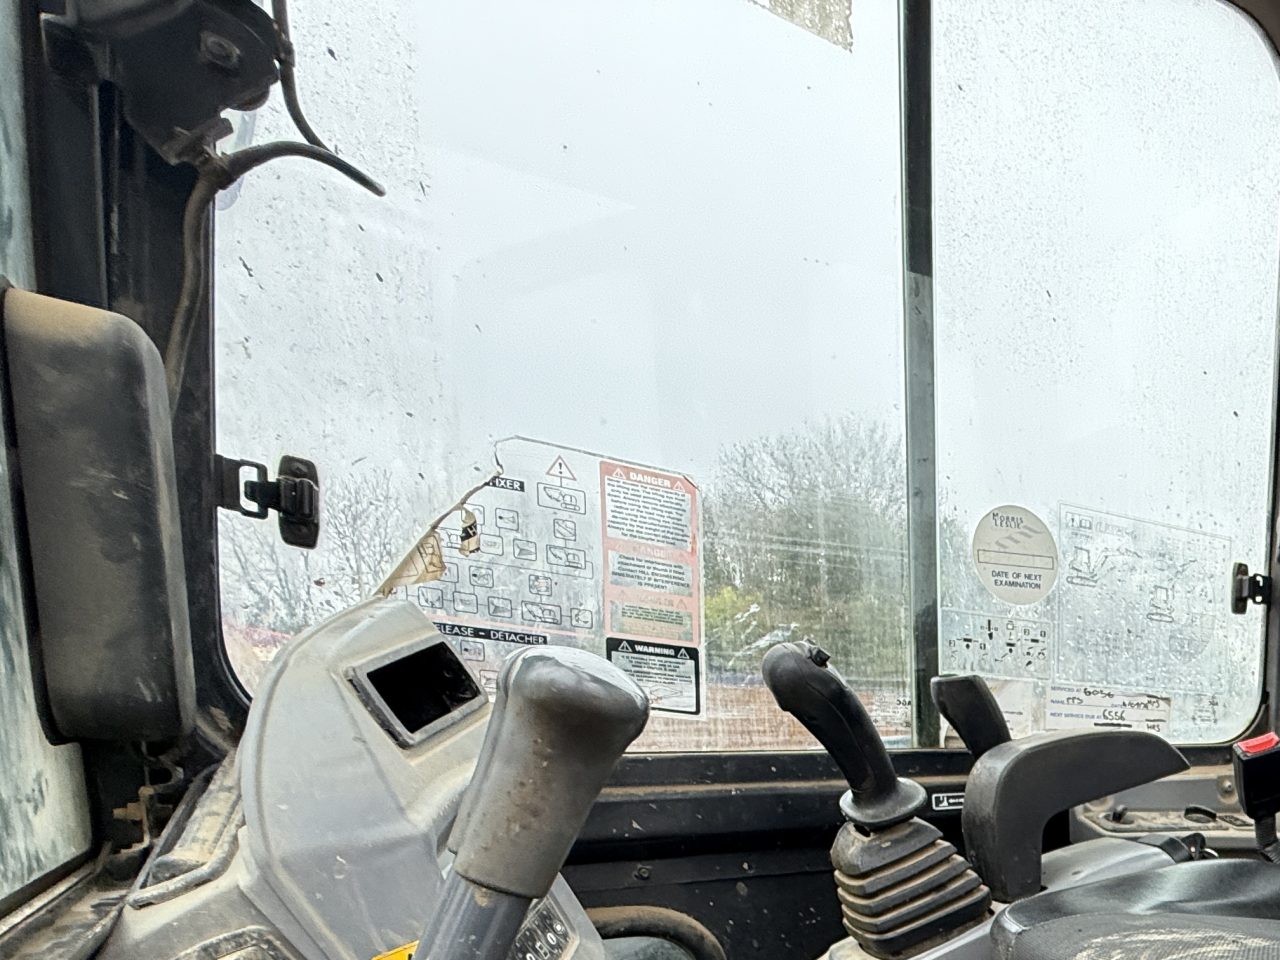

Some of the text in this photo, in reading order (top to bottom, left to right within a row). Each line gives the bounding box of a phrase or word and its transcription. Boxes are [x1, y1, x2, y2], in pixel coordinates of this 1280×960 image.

[630, 471, 671, 488] DANGER
[991, 570, 1042, 581] DATE OF NEXT
[994, 579, 1041, 589] EXAMINATION
[490, 630, 546, 645] DETACHER
[634, 645, 675, 656] WARNING
[1102, 708, 1126, 721] 6556
